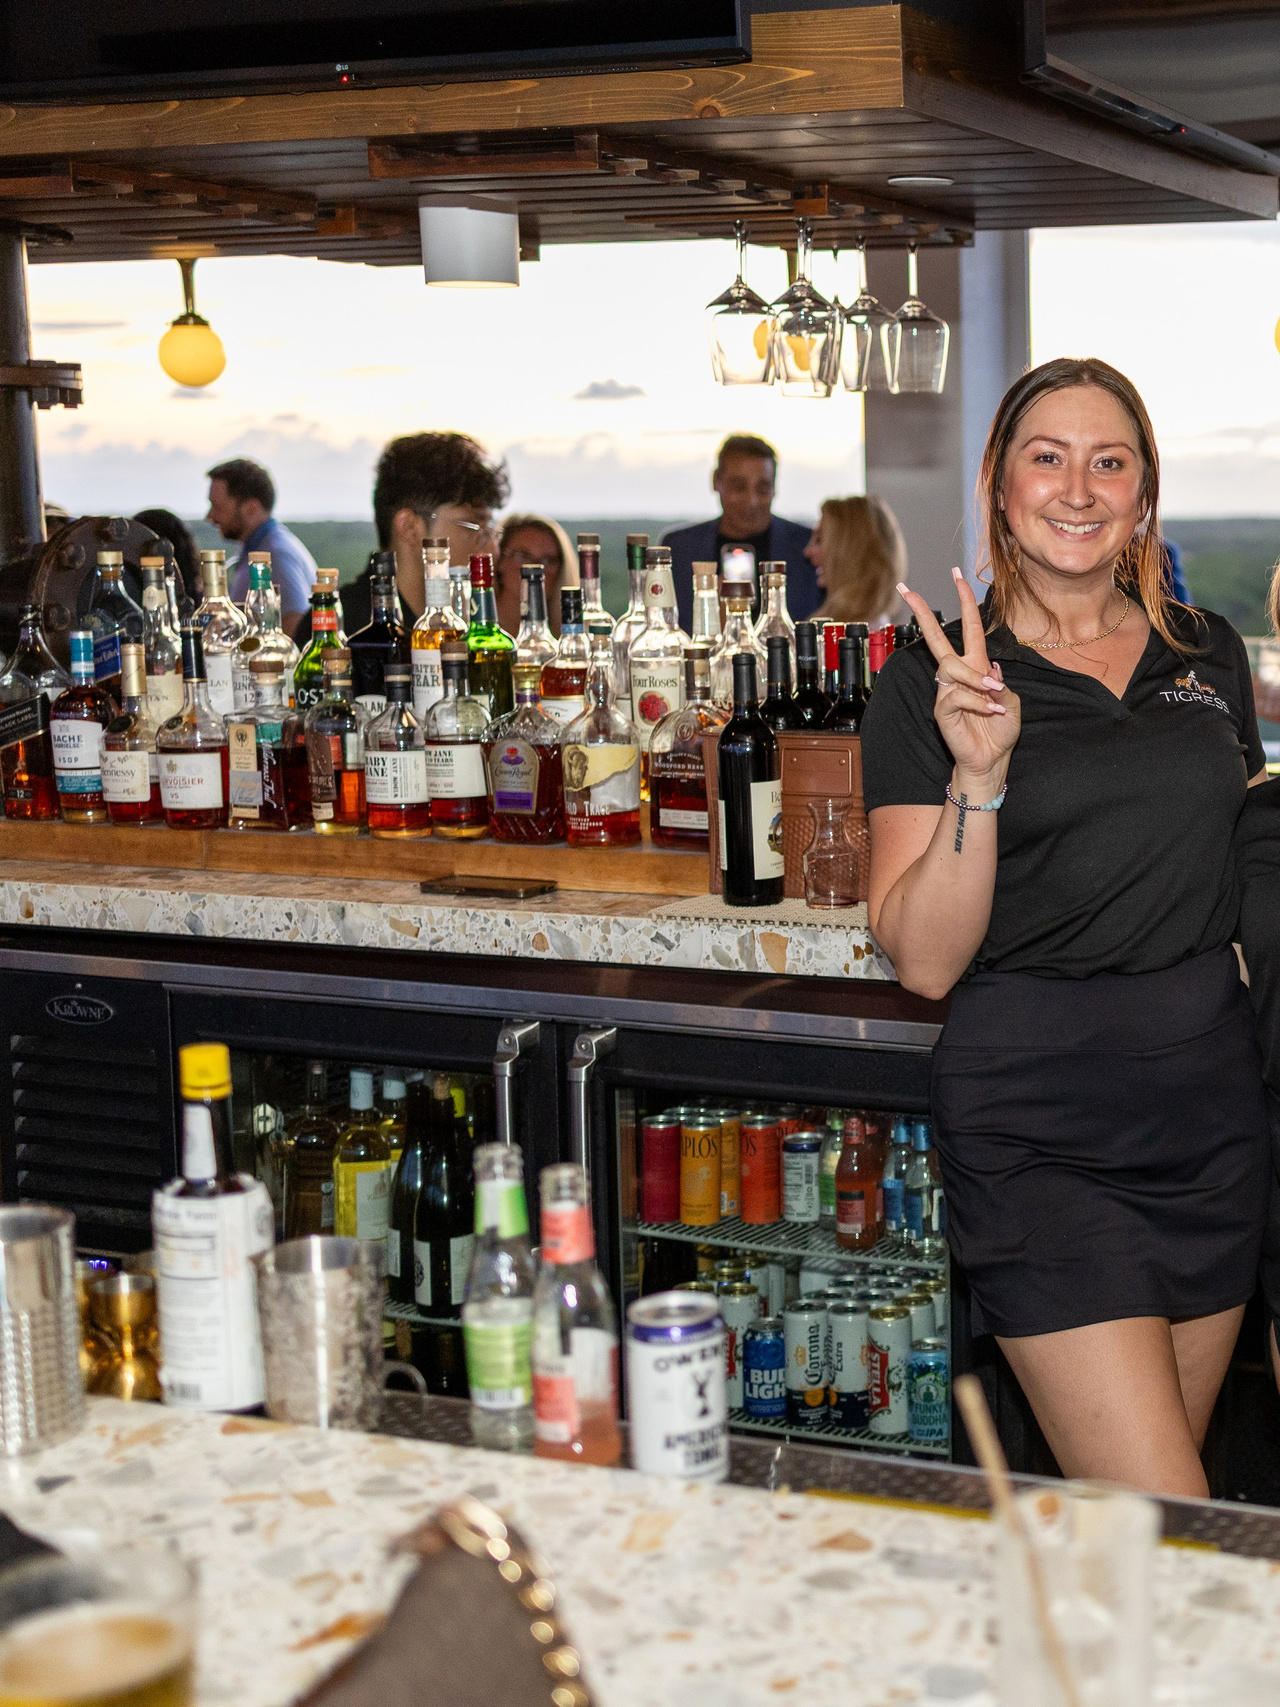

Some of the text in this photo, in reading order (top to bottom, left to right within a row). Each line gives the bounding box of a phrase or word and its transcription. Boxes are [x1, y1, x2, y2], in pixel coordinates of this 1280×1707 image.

[632, 675, 678, 688] Four Roses
[1159, 690, 1230, 714] TIGRESS
[433, 750, 453, 758] JANE
[687, 763, 704, 771] RESE
[16, 789, 25, 798] 12
[583, 800, 611, 817] TRACE
[53, 1000, 105, 1020] KROWNE
[804, 1323, 823, 1386] Corona
[834, 1341, 843, 1372] Extra
[870, 1352, 882, 1406] STELLA
[744, 1384, 786, 1400] LIGH
[914, 1402, 944, 1414] FUNKY
[926, 1428, 944, 1438] IPA
